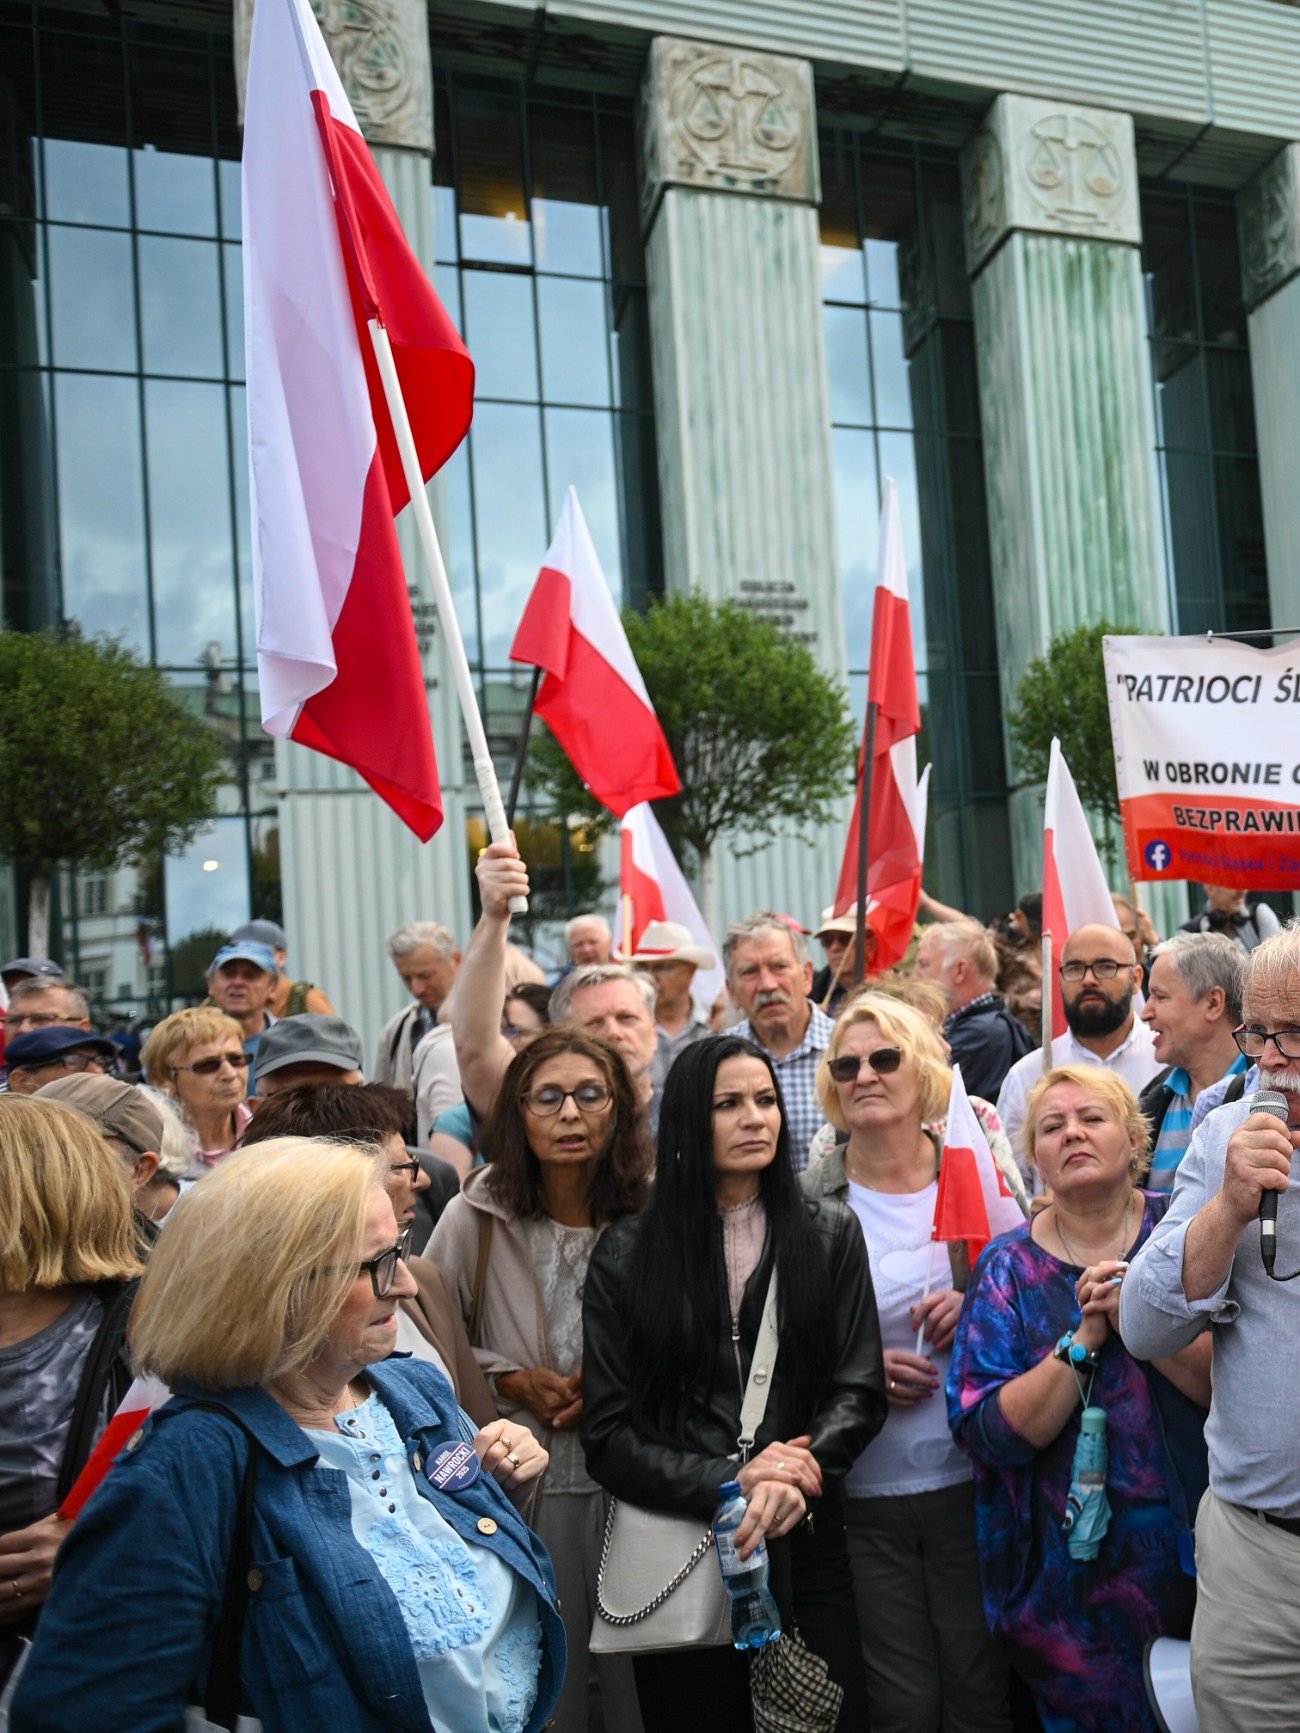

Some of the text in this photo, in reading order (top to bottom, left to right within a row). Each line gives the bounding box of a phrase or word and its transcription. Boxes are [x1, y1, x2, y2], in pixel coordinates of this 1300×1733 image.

[1143, 760, 1159, 782] W
[1165, 762, 1282, 785] OBRONIE
[433, 1446, 471, 1484] NAWROCKI
[455, 1465, 470, 1480] 2025
